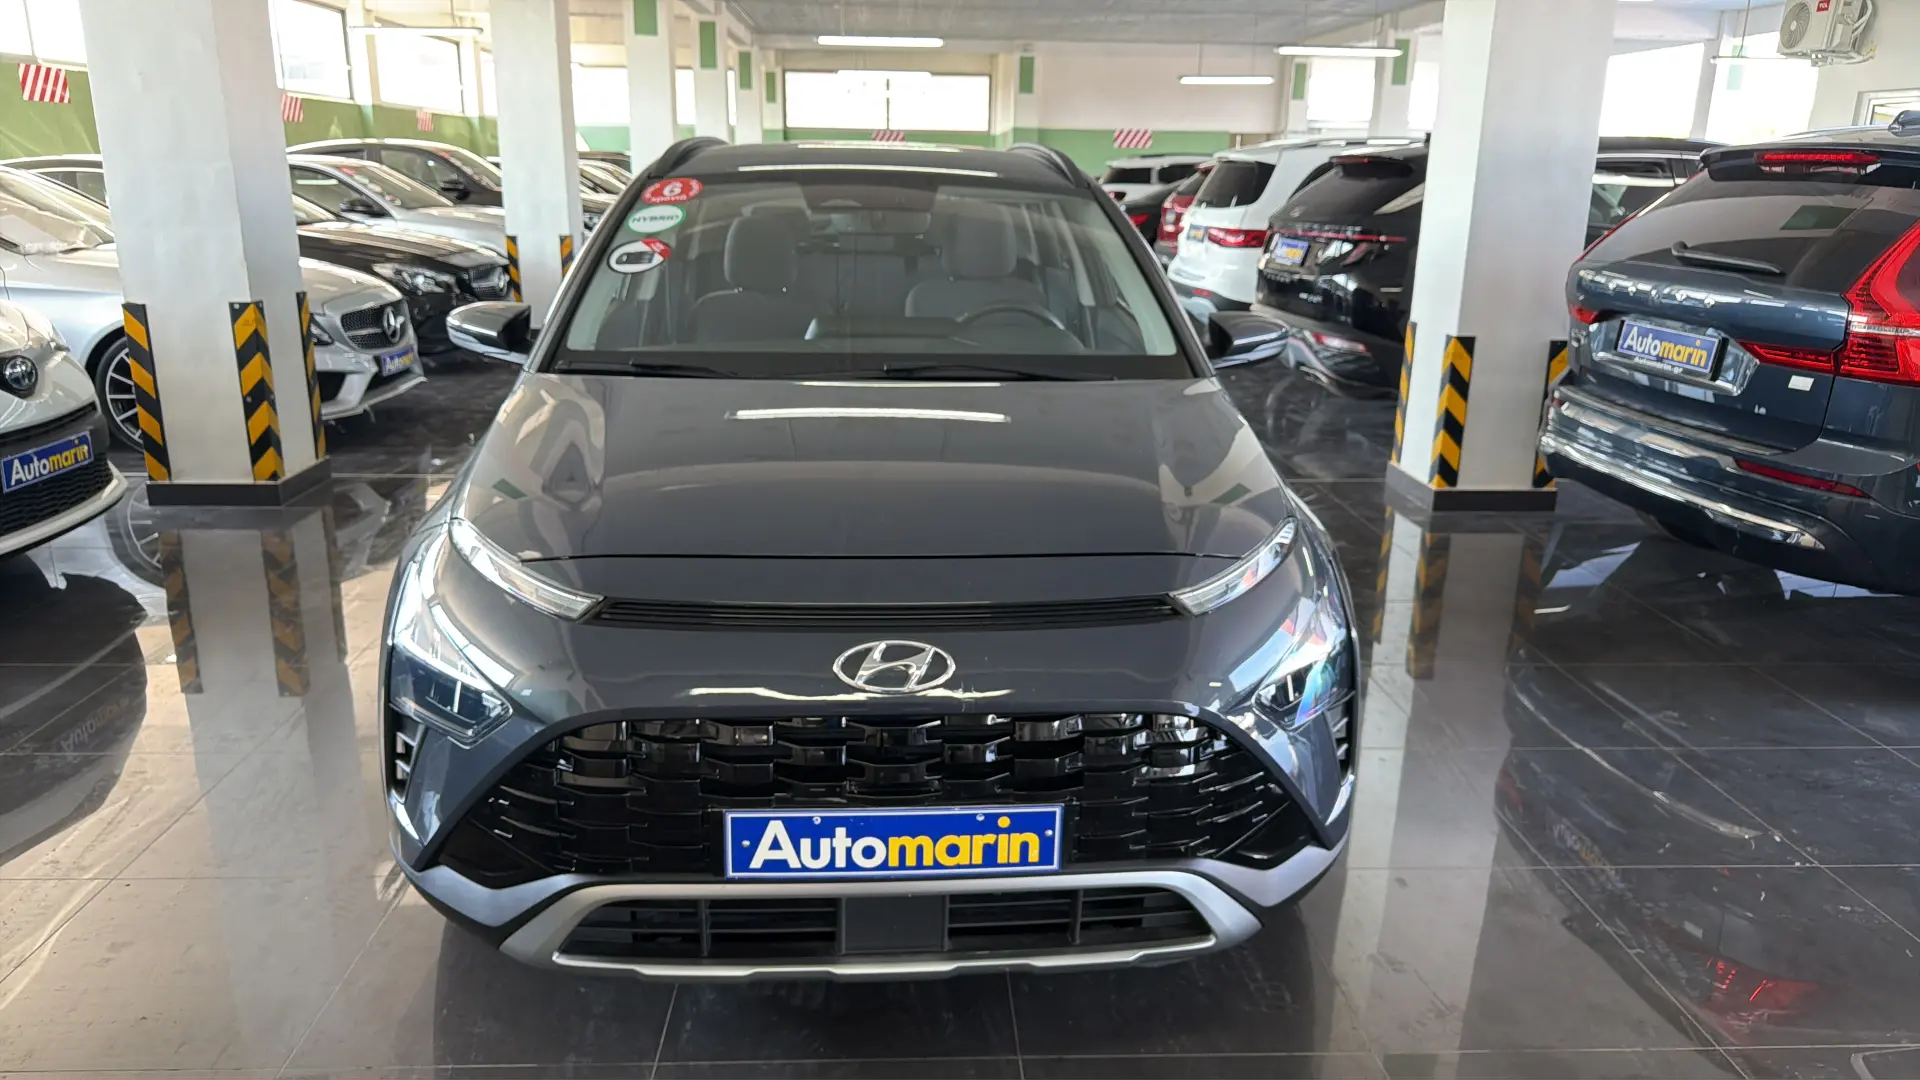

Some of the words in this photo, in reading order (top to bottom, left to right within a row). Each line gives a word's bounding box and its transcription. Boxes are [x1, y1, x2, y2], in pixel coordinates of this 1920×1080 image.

[662, 181, 683, 197] 6
[1623, 325, 1707, 367] Automarin
[11, 439, 89, 486] Automarin
[749, 816, 1040, 869] Automarin
